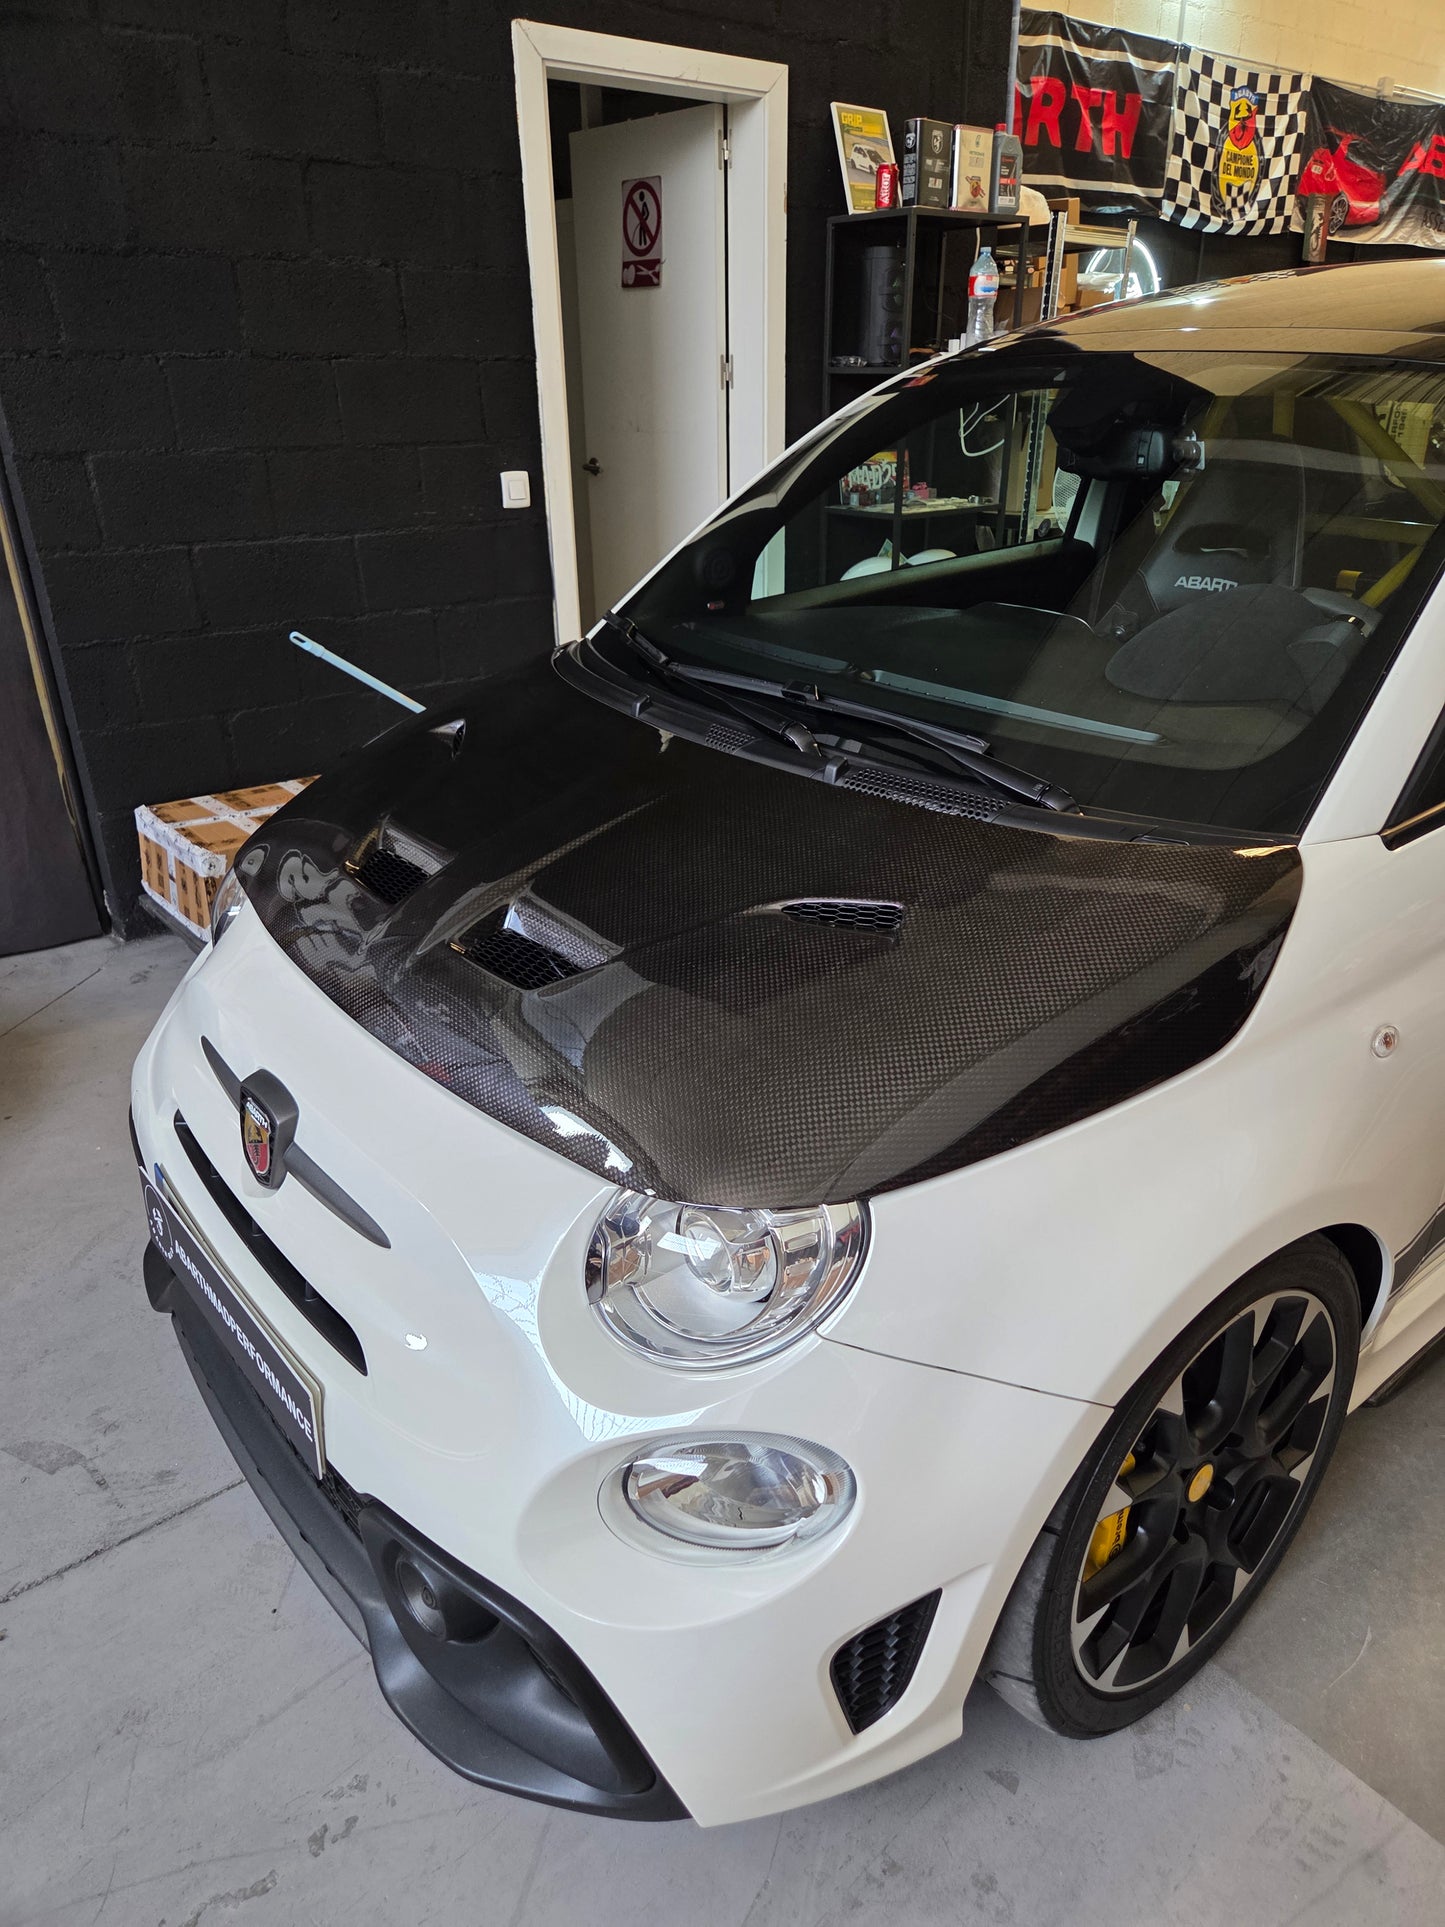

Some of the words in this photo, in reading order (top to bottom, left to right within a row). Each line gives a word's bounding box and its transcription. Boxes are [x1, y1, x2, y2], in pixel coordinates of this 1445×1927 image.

[1226, 151, 1253, 166] CAMPIONE
[1223, 162, 1232, 176] DEL
[1233, 164, 1255, 179] MONDO
[1174, 576, 1238, 592] ABART
[246, 1101, 268, 1129] ABARTH
[1112, 1508, 1124, 1545] brem
